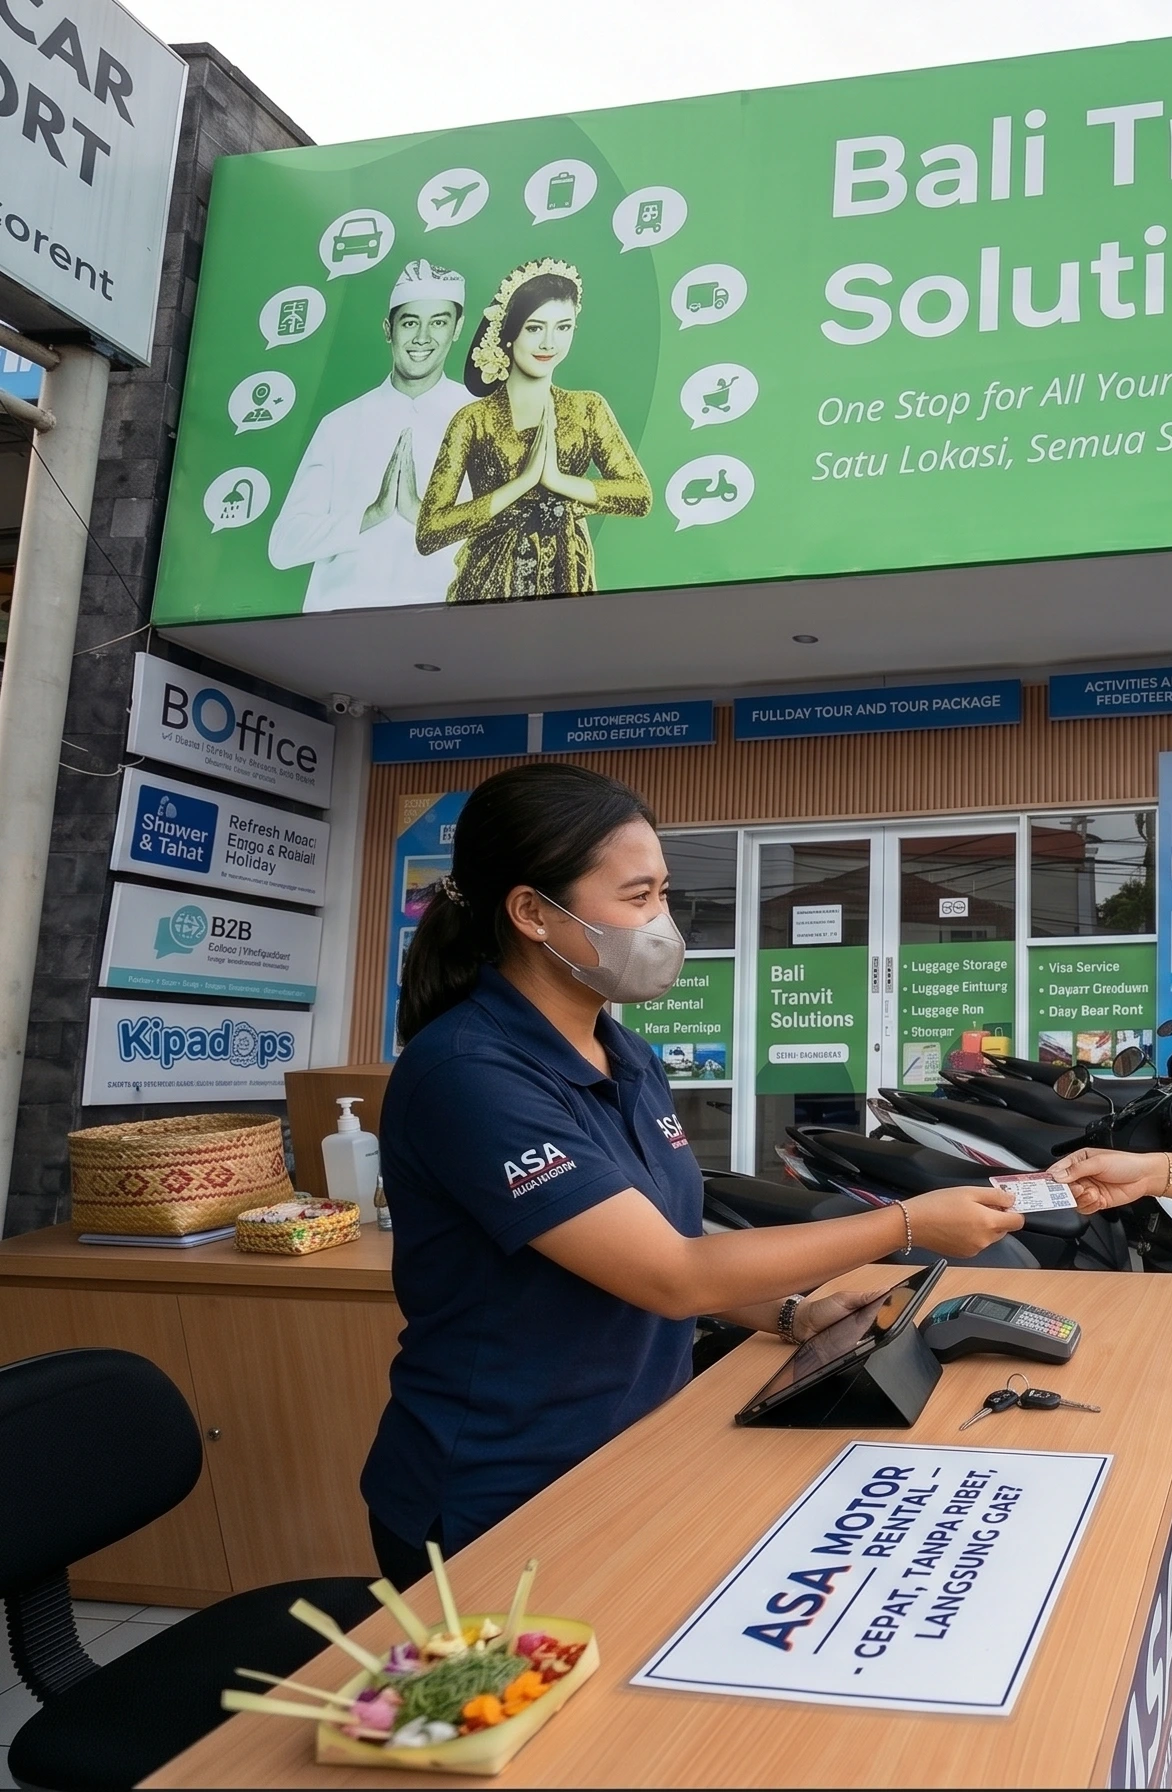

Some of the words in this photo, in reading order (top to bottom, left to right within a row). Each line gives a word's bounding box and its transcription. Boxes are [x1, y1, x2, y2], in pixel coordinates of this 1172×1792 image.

[832, 108, 1047, 218] Bali
[0, 203, 113, 302] orent
[817, 397, 886, 427] One
[894, 389, 971, 425] Stop
[976, 381, 1034, 422] for
[1040, 373, 1086, 408] All
[811, 449, 889, 481] Satu
[899, 437, 1015, 475] Lokasi,
[1026, 428, 1146, 464] Semua
[1084, 678, 1158, 693] ACTIVITIES
[652, 711, 680, 723] AND
[752, 707, 812, 722] FULLDAY
[814, 704, 853, 718] TOUR
[856, 702, 887, 716] AND
[889, 699, 929, 714] TOUR
[932, 695, 1001, 711] PACKAGE
[409, 726, 443, 739] PUGA
[428, 739, 462, 751] TOWT
[229, 814, 281, 840] Refresh
[139, 834, 152, 852] &
[158, 836, 204, 862] Tahat
[266, 844, 276, 856] &
[225, 849, 277, 876] Holiday
[210, 916, 253, 941] B2B
[770, 964, 805, 982] Bali
[911, 961, 960, 974] Luggage
[962, 959, 1008, 972] Storage
[1048, 962, 1073, 973] Visa
[1076, 961, 1120, 973] Service
[770, 988, 833, 1006] Tranvit
[911, 983, 960, 996] Luggage
[644, 999, 664, 1011] Car
[667, 998, 704, 1011] Rental
[911, 1005, 960, 1018] Luggage
[1081, 1005, 1110, 1016] Bear
[1112, 1003, 1144, 1016] Ront
[770, 1011, 854, 1029] Solutions
[656, 1113, 683, 1138] ASA
[503, 1142, 567, 1185] ASA
[861, 1484, 939, 1557] RENTAL
[741, 1564, 853, 1652] ASA
[810, 1466, 916, 1556] MOTOR
[854, 1586, 928, 1658] CEPAT,
[901, 1519, 964, 1578] TANPA
[942, 1469, 998, 1516] RIBET,
[914, 1529, 1000, 1639] LANGSUNG
